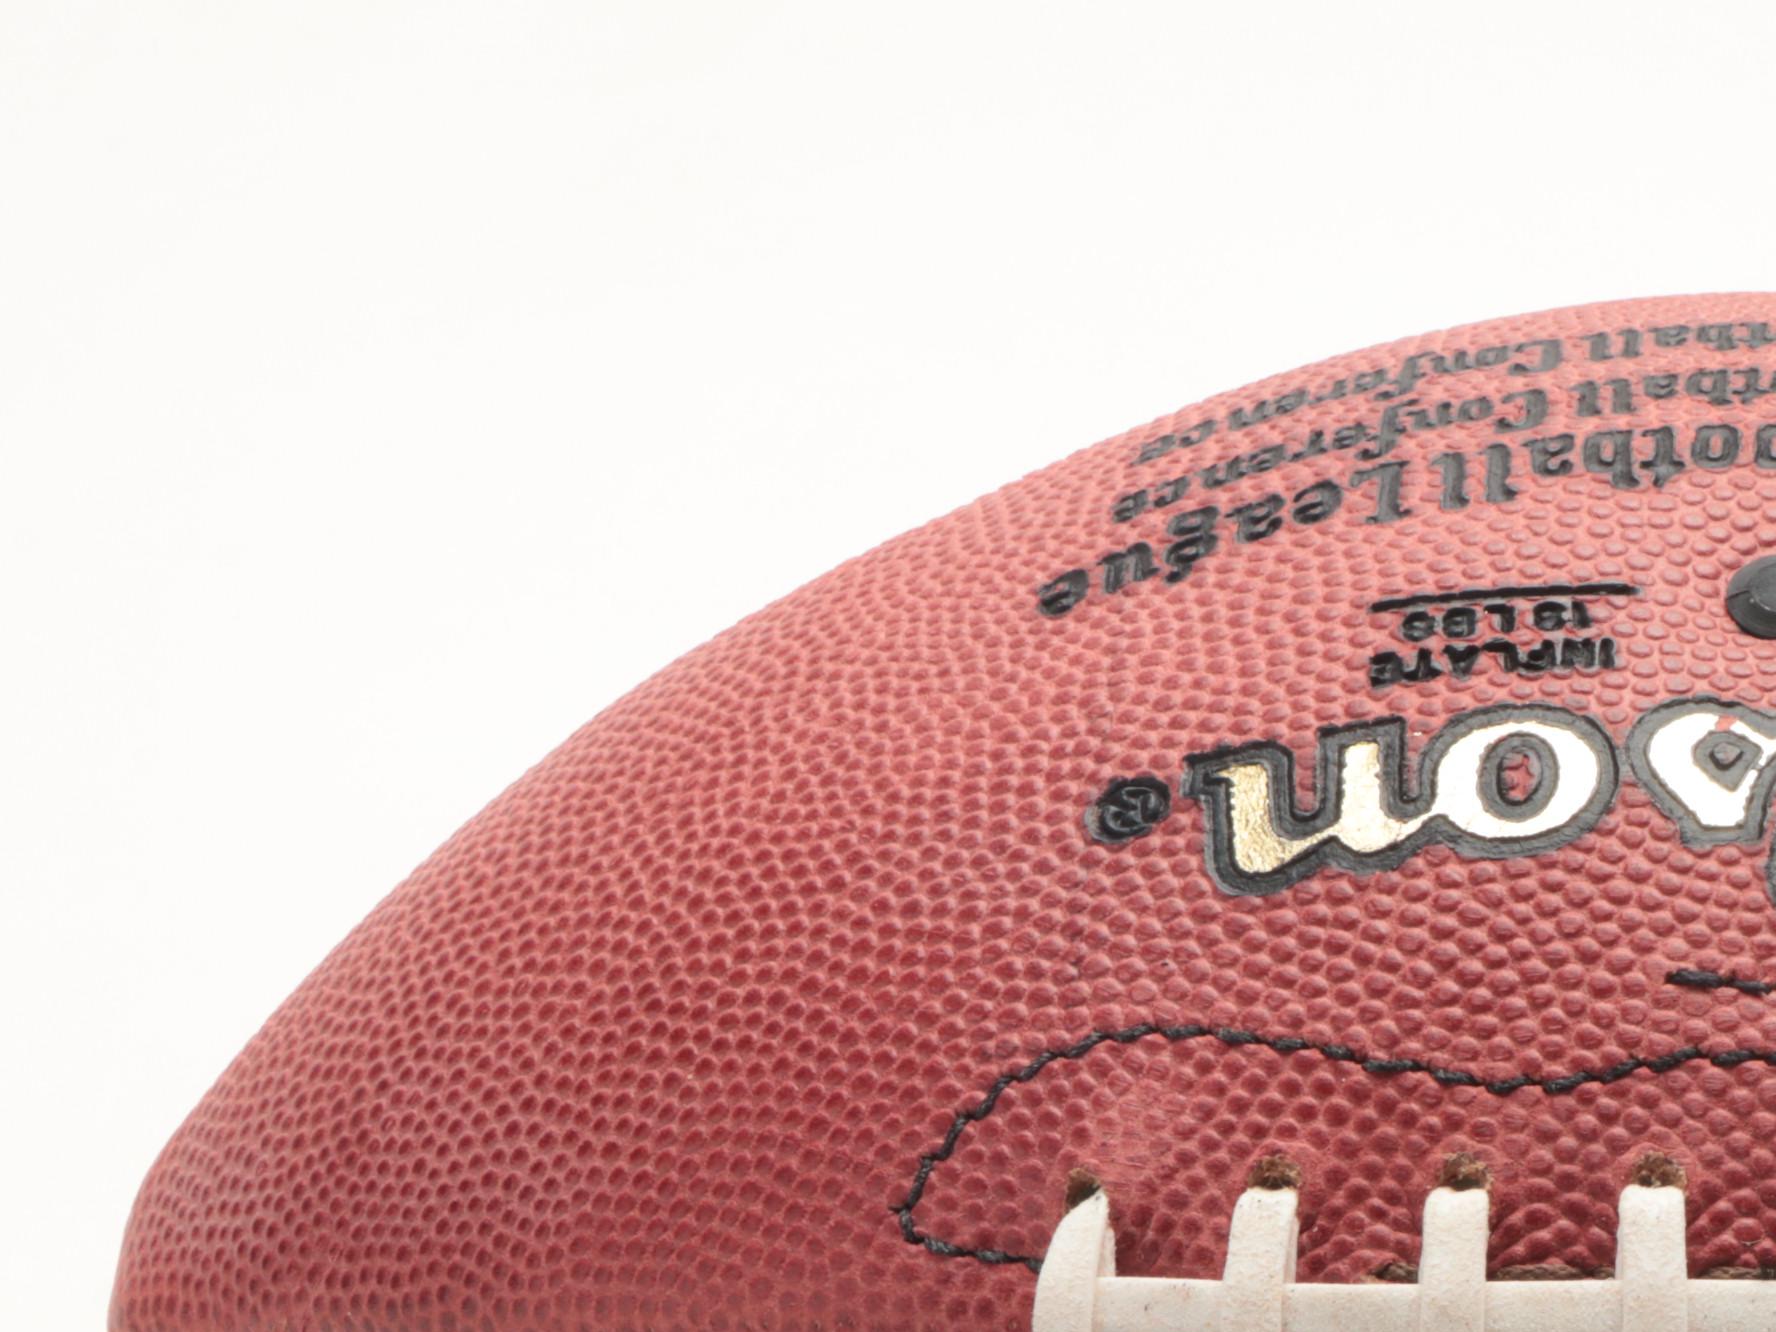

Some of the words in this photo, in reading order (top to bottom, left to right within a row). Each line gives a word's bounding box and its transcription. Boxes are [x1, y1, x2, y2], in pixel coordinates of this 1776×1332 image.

[1111, 387, 1550, 523] Conference
[1132, 337, 1564, 466] Conference
[1036, 459, 1412, 617] League
[1368, 637, 1616, 689] INFLATE
